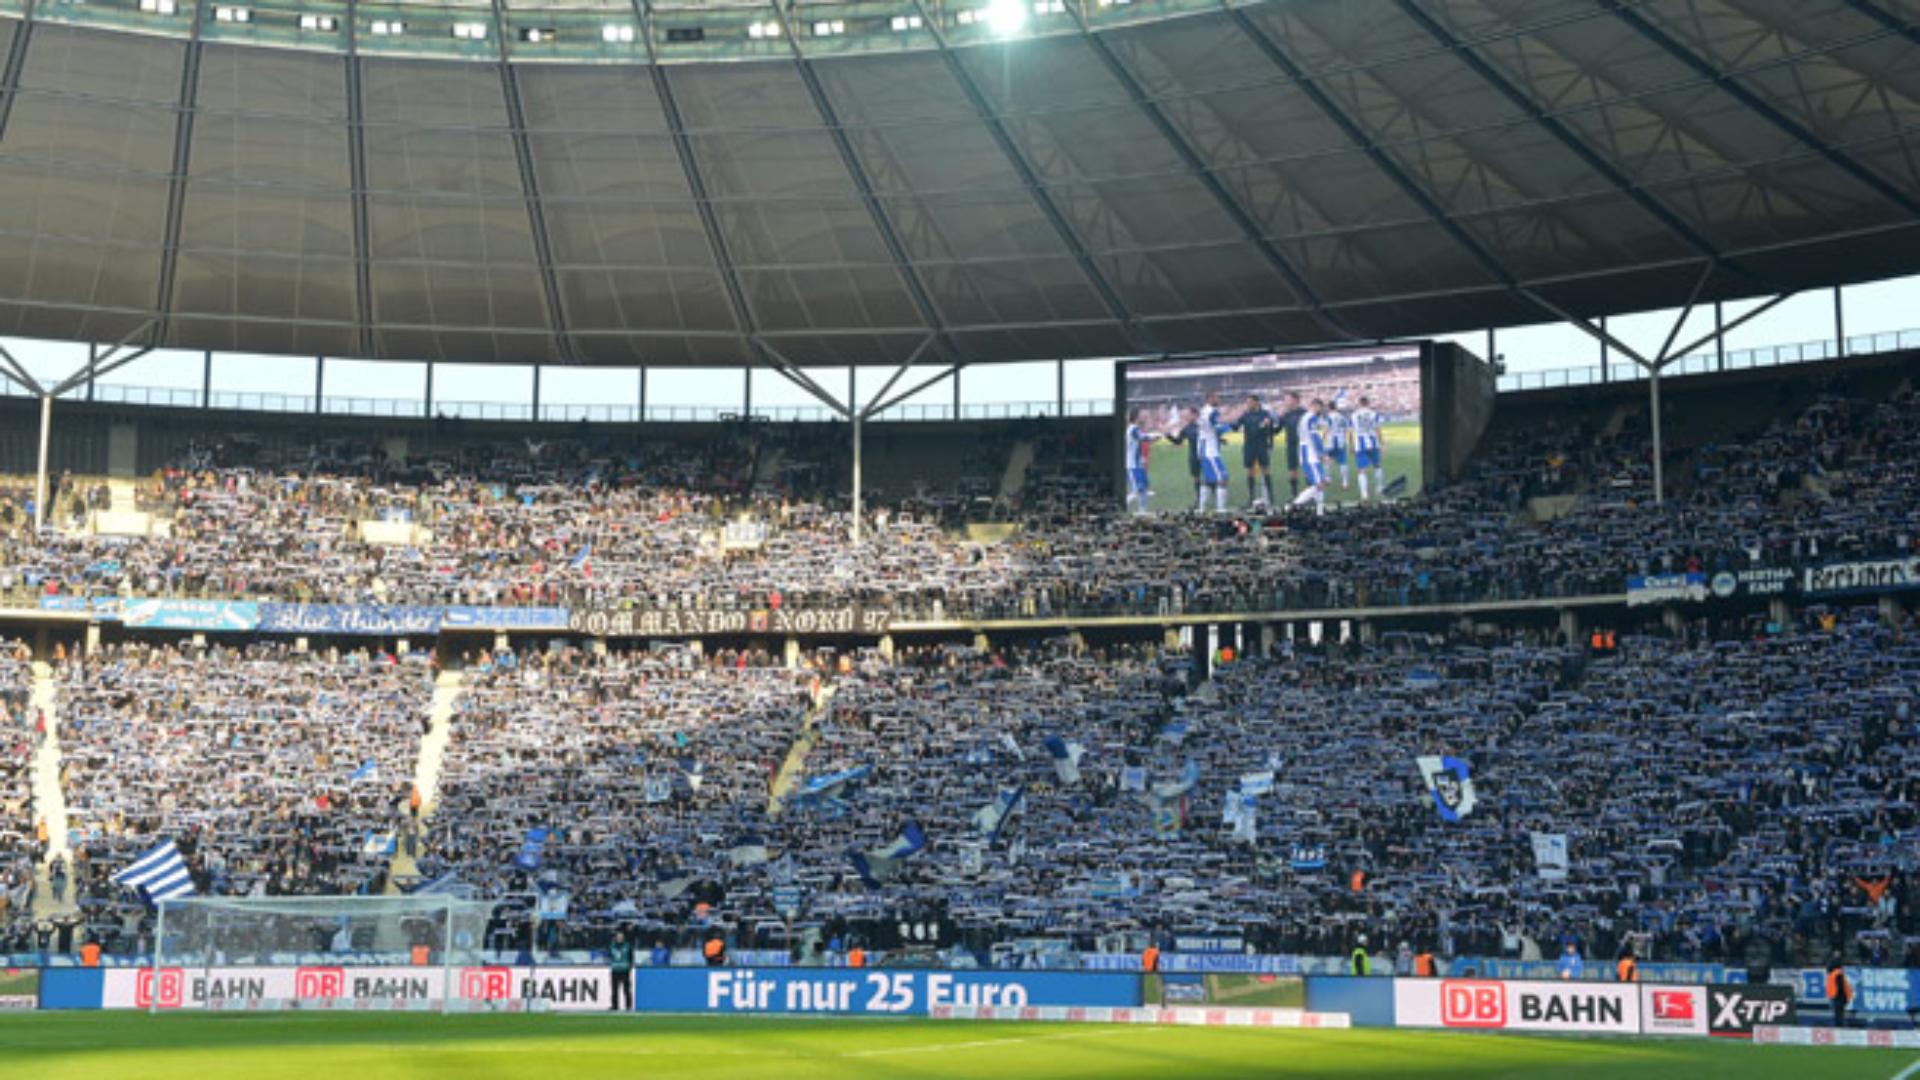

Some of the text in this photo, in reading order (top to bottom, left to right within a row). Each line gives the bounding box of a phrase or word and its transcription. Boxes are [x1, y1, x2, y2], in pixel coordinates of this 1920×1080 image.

[192, 977, 265, 1000] BAHN
[353, 977, 428, 1000] BAHN
[521, 977, 599, 1002] BAHN
[708, 969, 1027, 1011] Für nur 25 Euro
[1446, 985, 1622, 1023] DB BAHN
